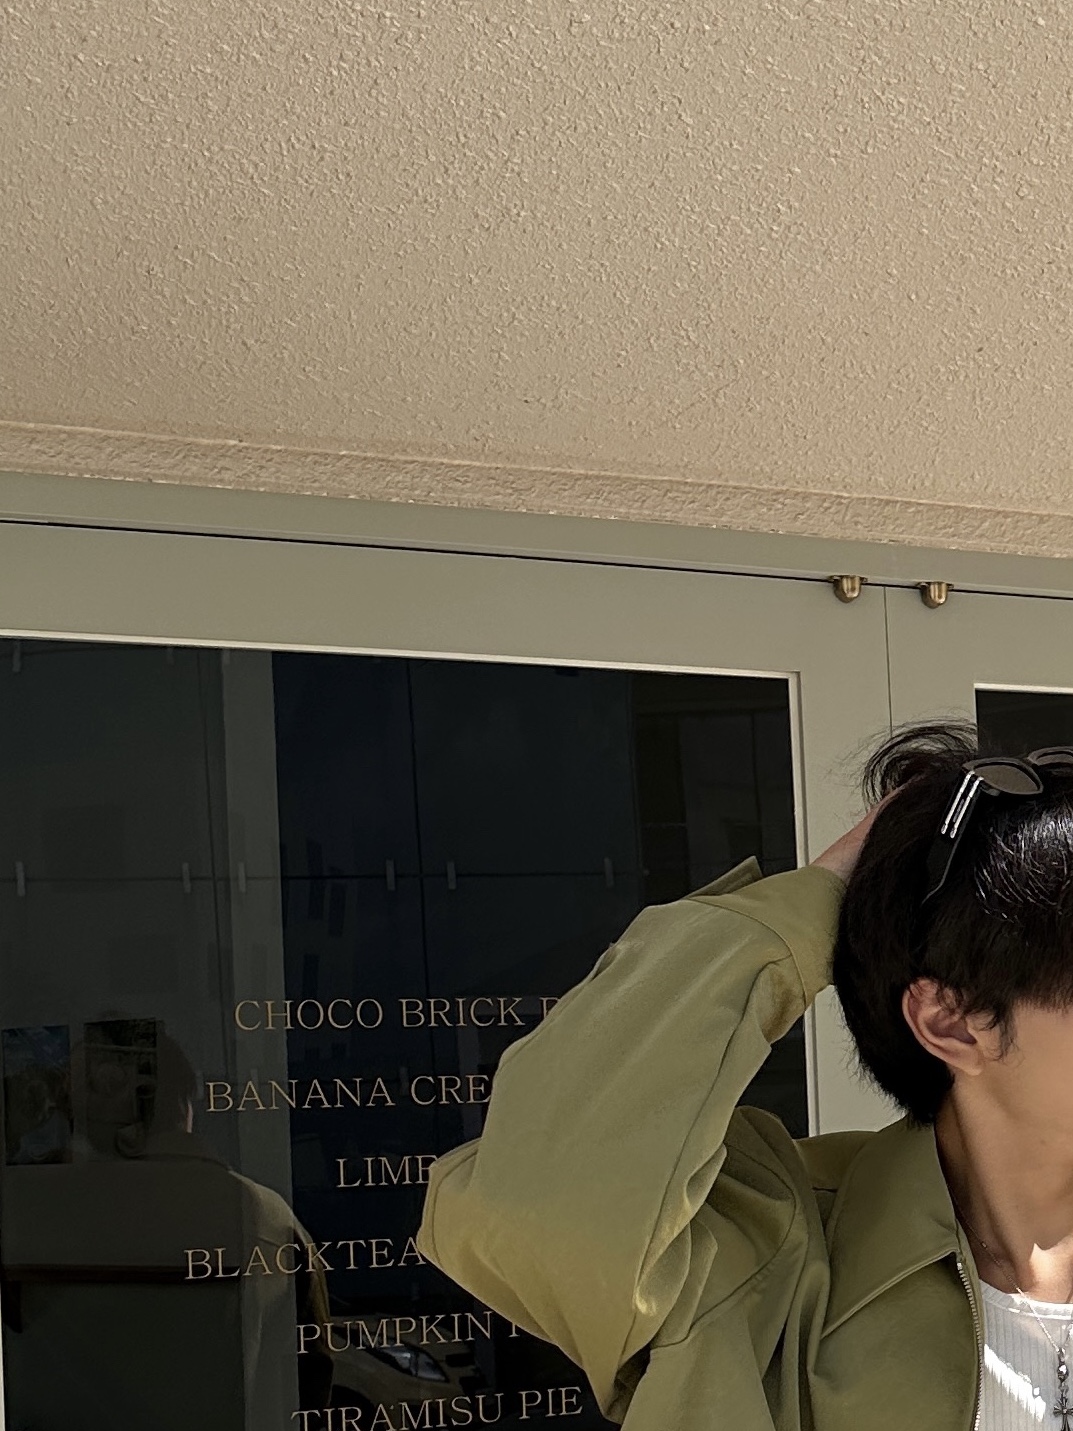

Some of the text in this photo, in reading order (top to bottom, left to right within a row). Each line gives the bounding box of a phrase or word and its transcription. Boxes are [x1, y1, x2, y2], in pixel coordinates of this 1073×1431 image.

[234, 998, 384, 1031] CHOCO
[400, 996, 527, 1028] BRICK
[206, 1073, 492, 1112] BANANA CRE
[336, 1153, 438, 1188] LIME
[184, 1236, 426, 1280] BLACKTEA
[296, 1310, 494, 1355] PUMPKIN
[519, 1386, 583, 1420] PIE
